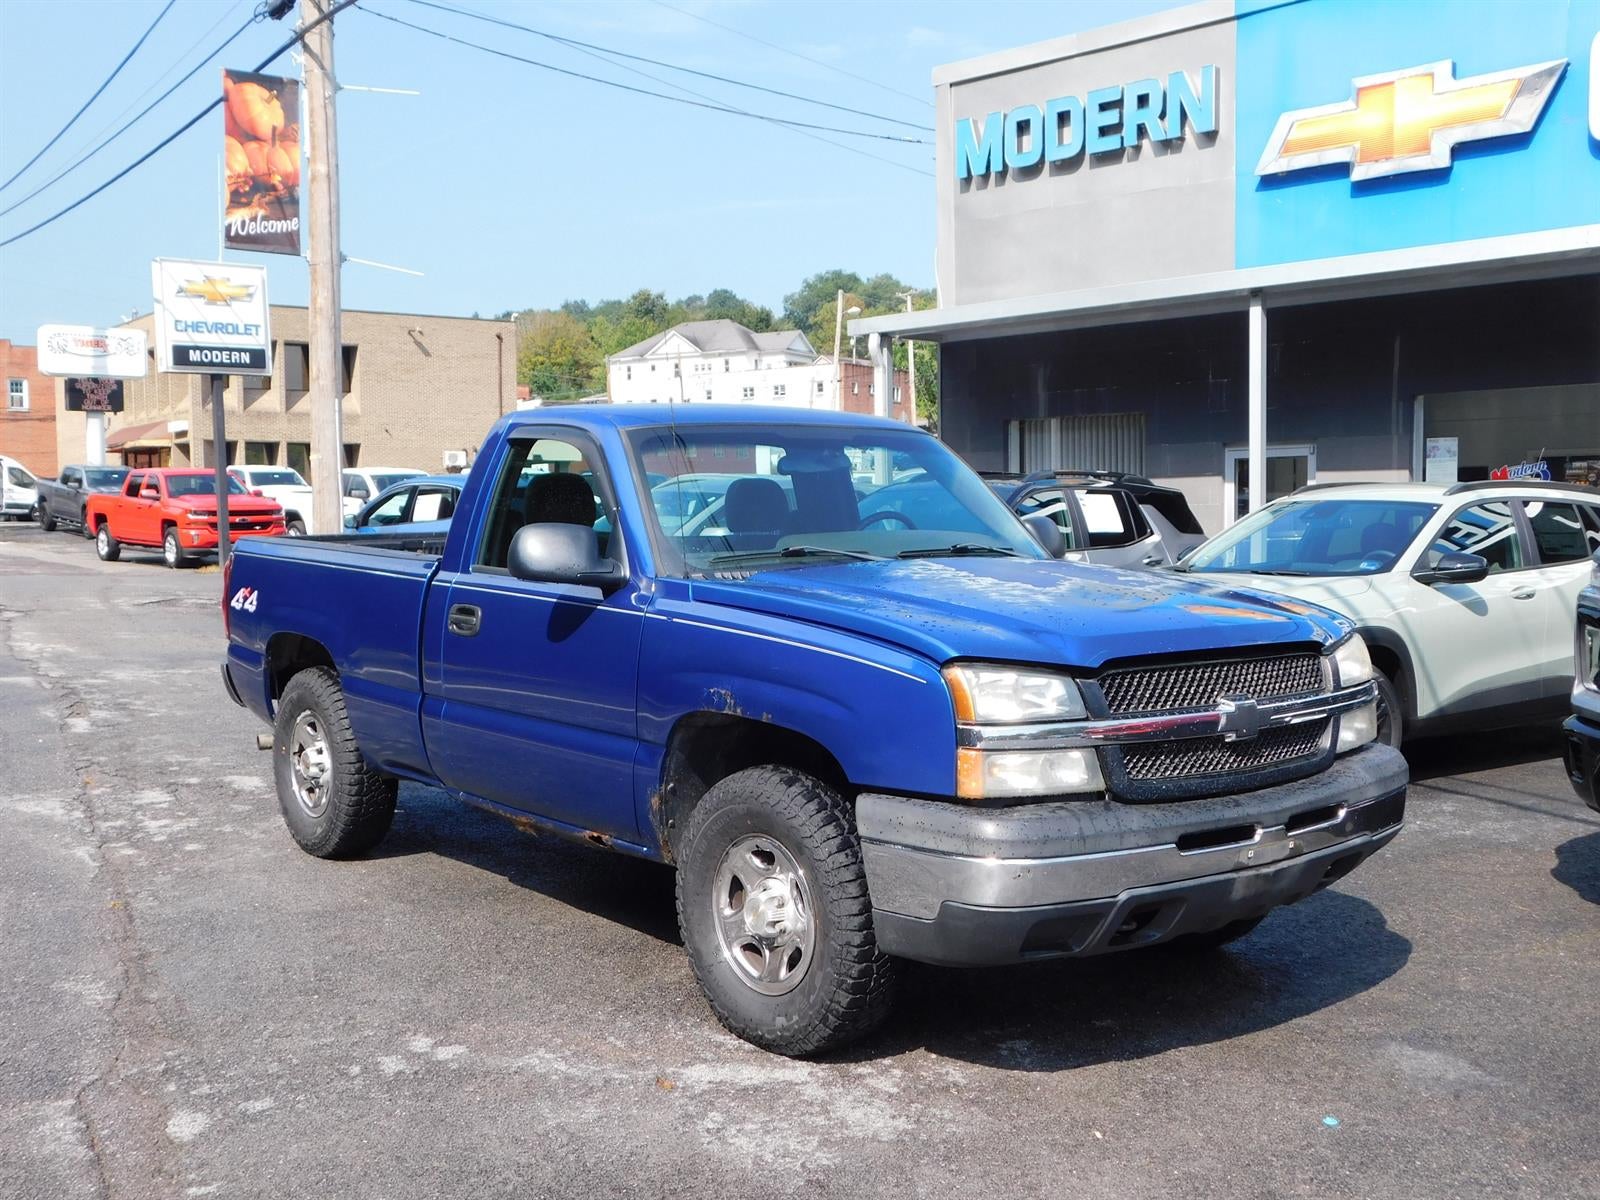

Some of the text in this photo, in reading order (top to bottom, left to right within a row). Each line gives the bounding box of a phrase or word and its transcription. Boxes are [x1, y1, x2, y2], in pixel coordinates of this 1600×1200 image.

[956, 64, 1219, 178] MODERN
[225, 212, 299, 237] Welcome
[174, 320, 261, 336] CHEVROLET
[189, 349, 250, 364] MODERN
[1490, 460, 1547, 481] Modern
